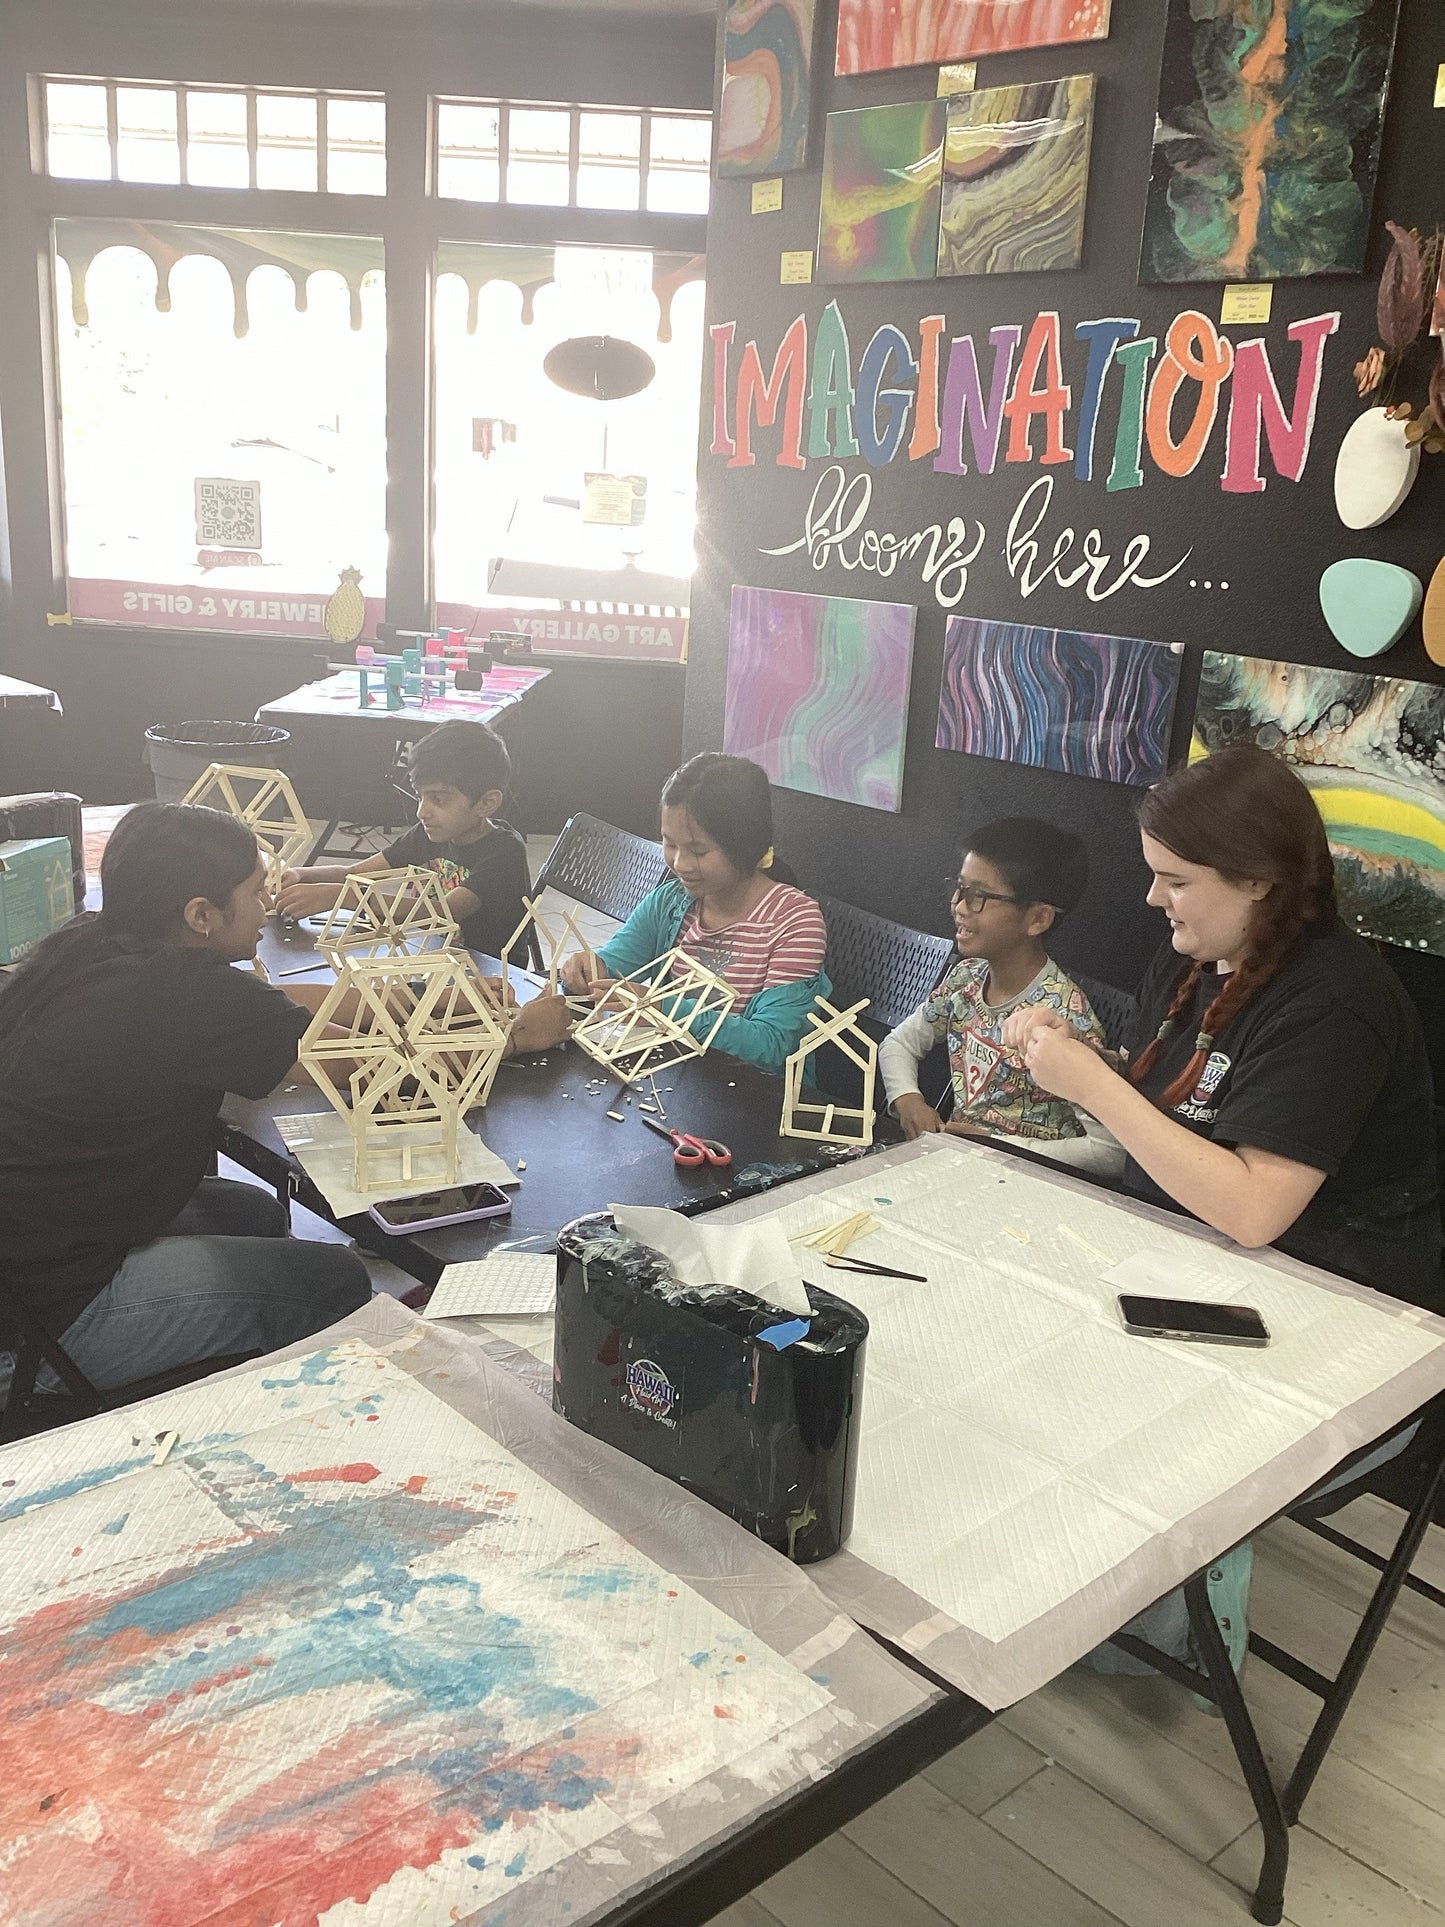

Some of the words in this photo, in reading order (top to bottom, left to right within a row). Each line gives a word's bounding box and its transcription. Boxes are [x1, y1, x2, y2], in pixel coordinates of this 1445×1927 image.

[708, 297, 1342, 493] IMAGINATION
[758, 465, 986, 607] blooms
[626, 1363, 674, 1408] HAWAII
